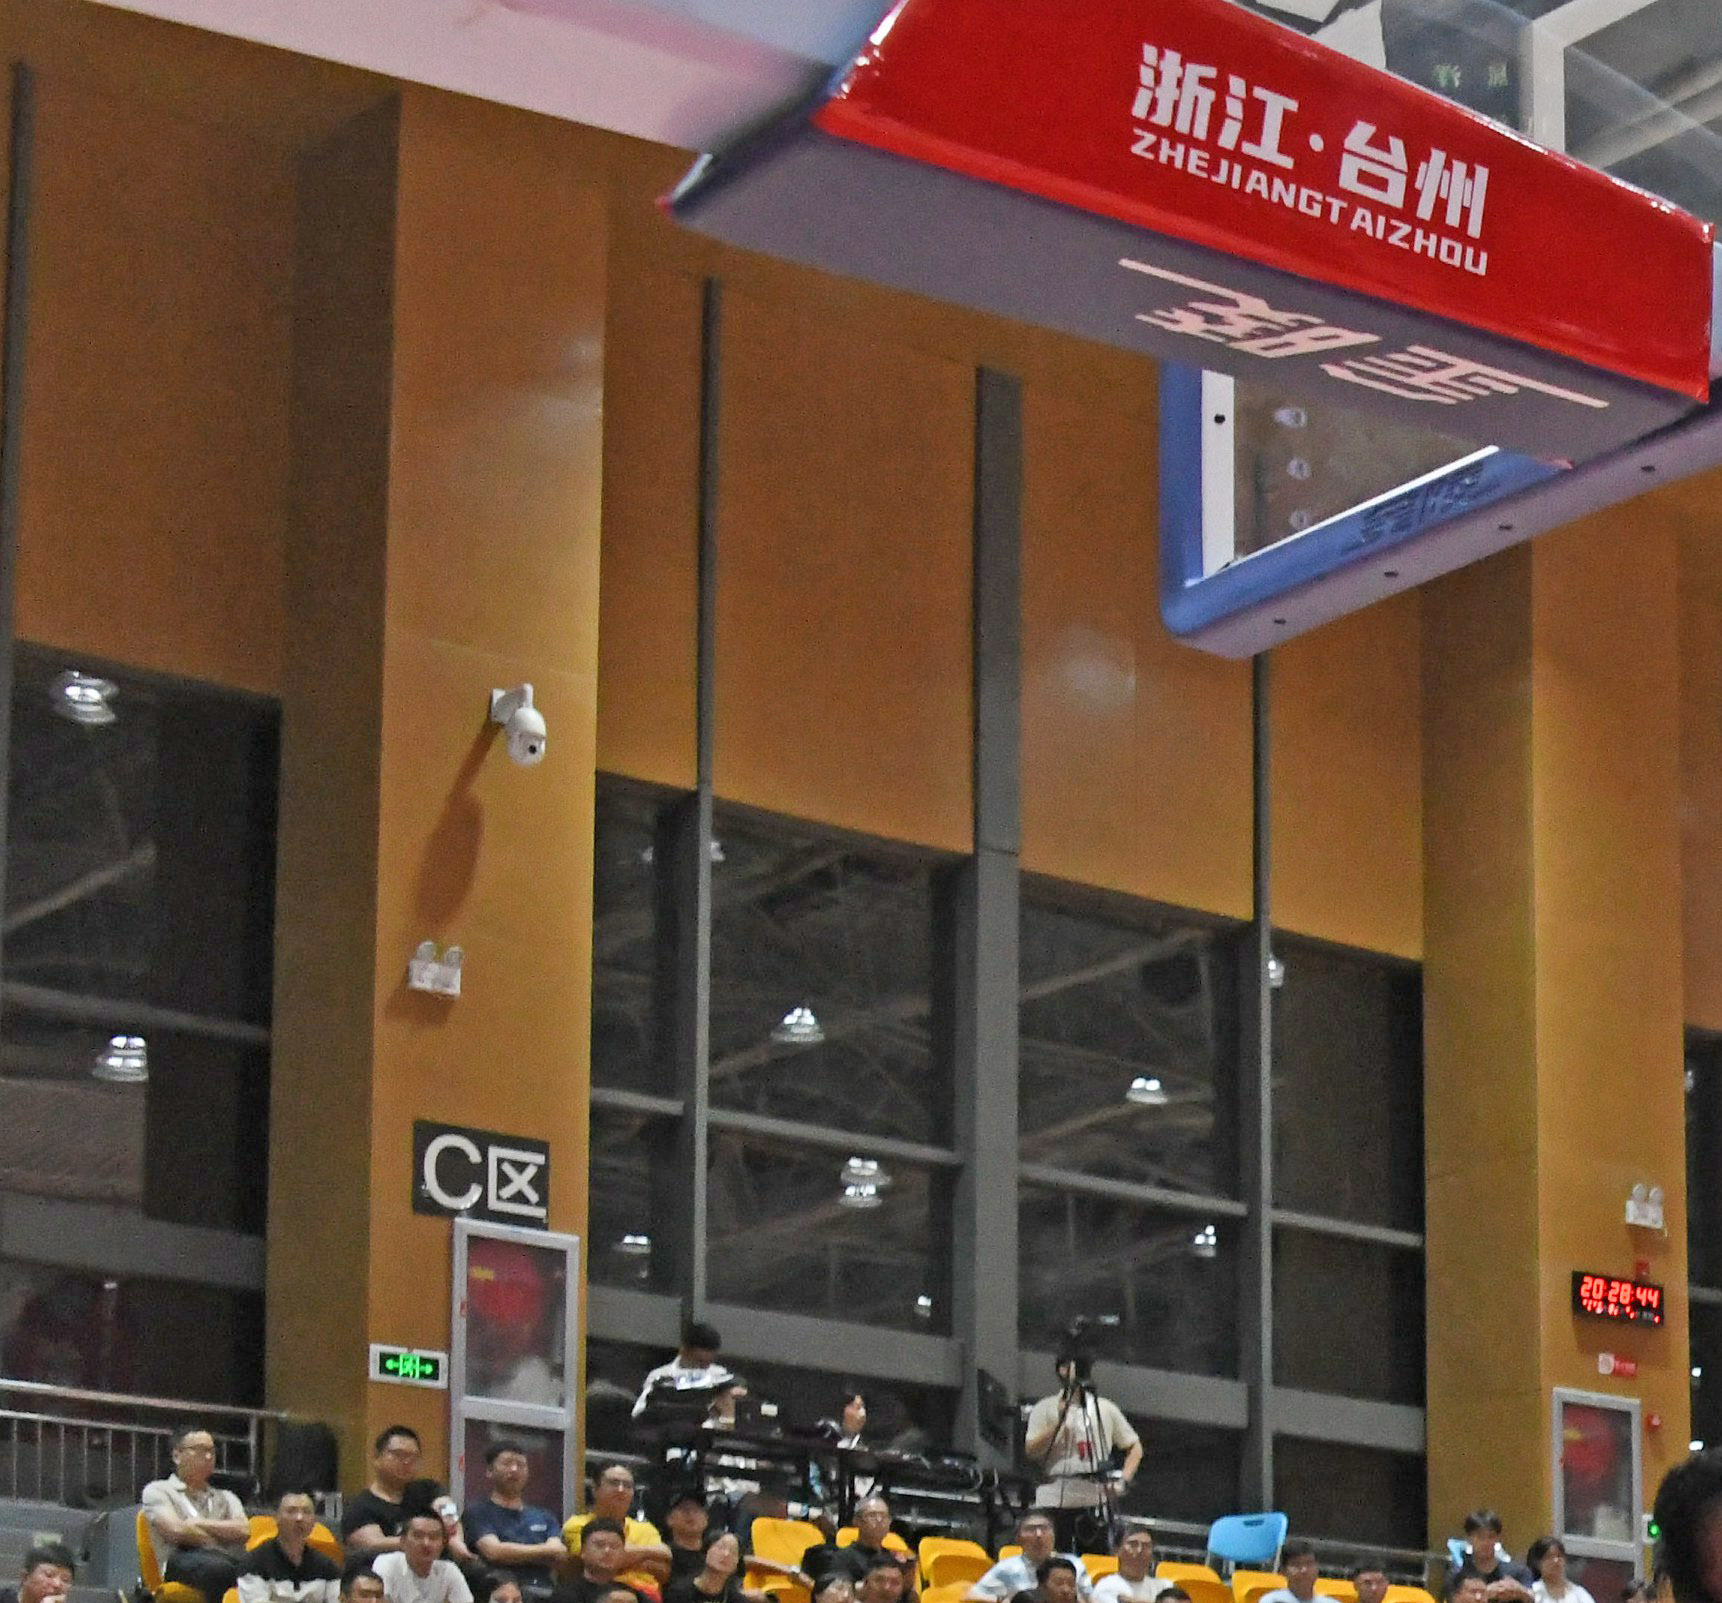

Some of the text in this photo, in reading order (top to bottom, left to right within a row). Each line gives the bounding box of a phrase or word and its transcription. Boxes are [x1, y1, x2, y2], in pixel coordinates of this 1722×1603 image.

[1131, 43, 1490, 239] 浙江·台州
[1130, 127, 1489, 277] ZHEJIANGTAIZHOU
[422, 1134, 547, 1219] C区
[1580, 1275, 1660, 1309] 20:28:44
